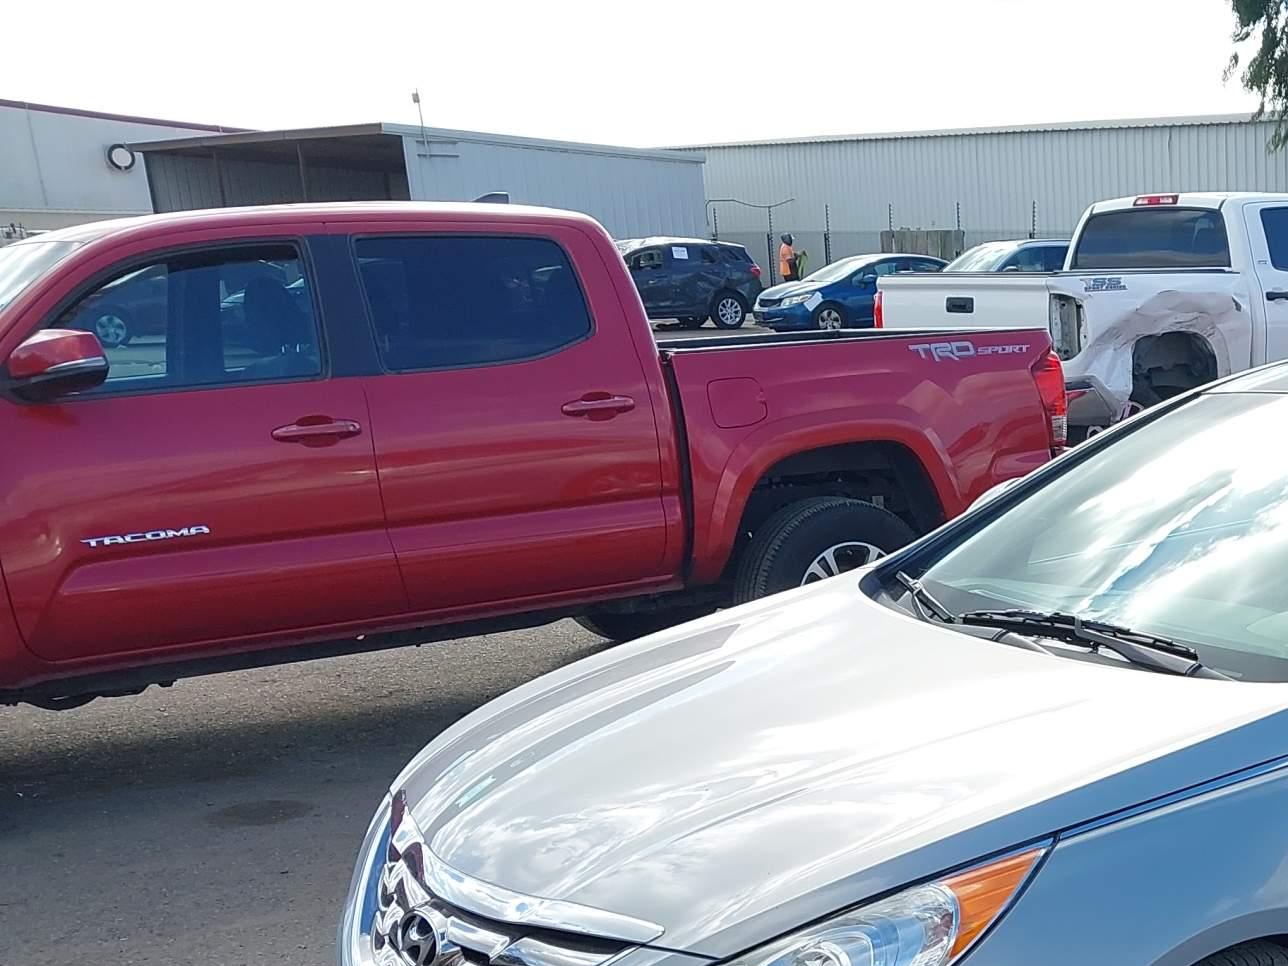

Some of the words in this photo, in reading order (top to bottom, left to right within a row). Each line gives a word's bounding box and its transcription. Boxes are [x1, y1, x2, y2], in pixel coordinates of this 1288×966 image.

[908, 341, 976, 362] TRD
[977, 344, 1030, 355] SPORT
[80, 525, 210, 547] TACOMA
